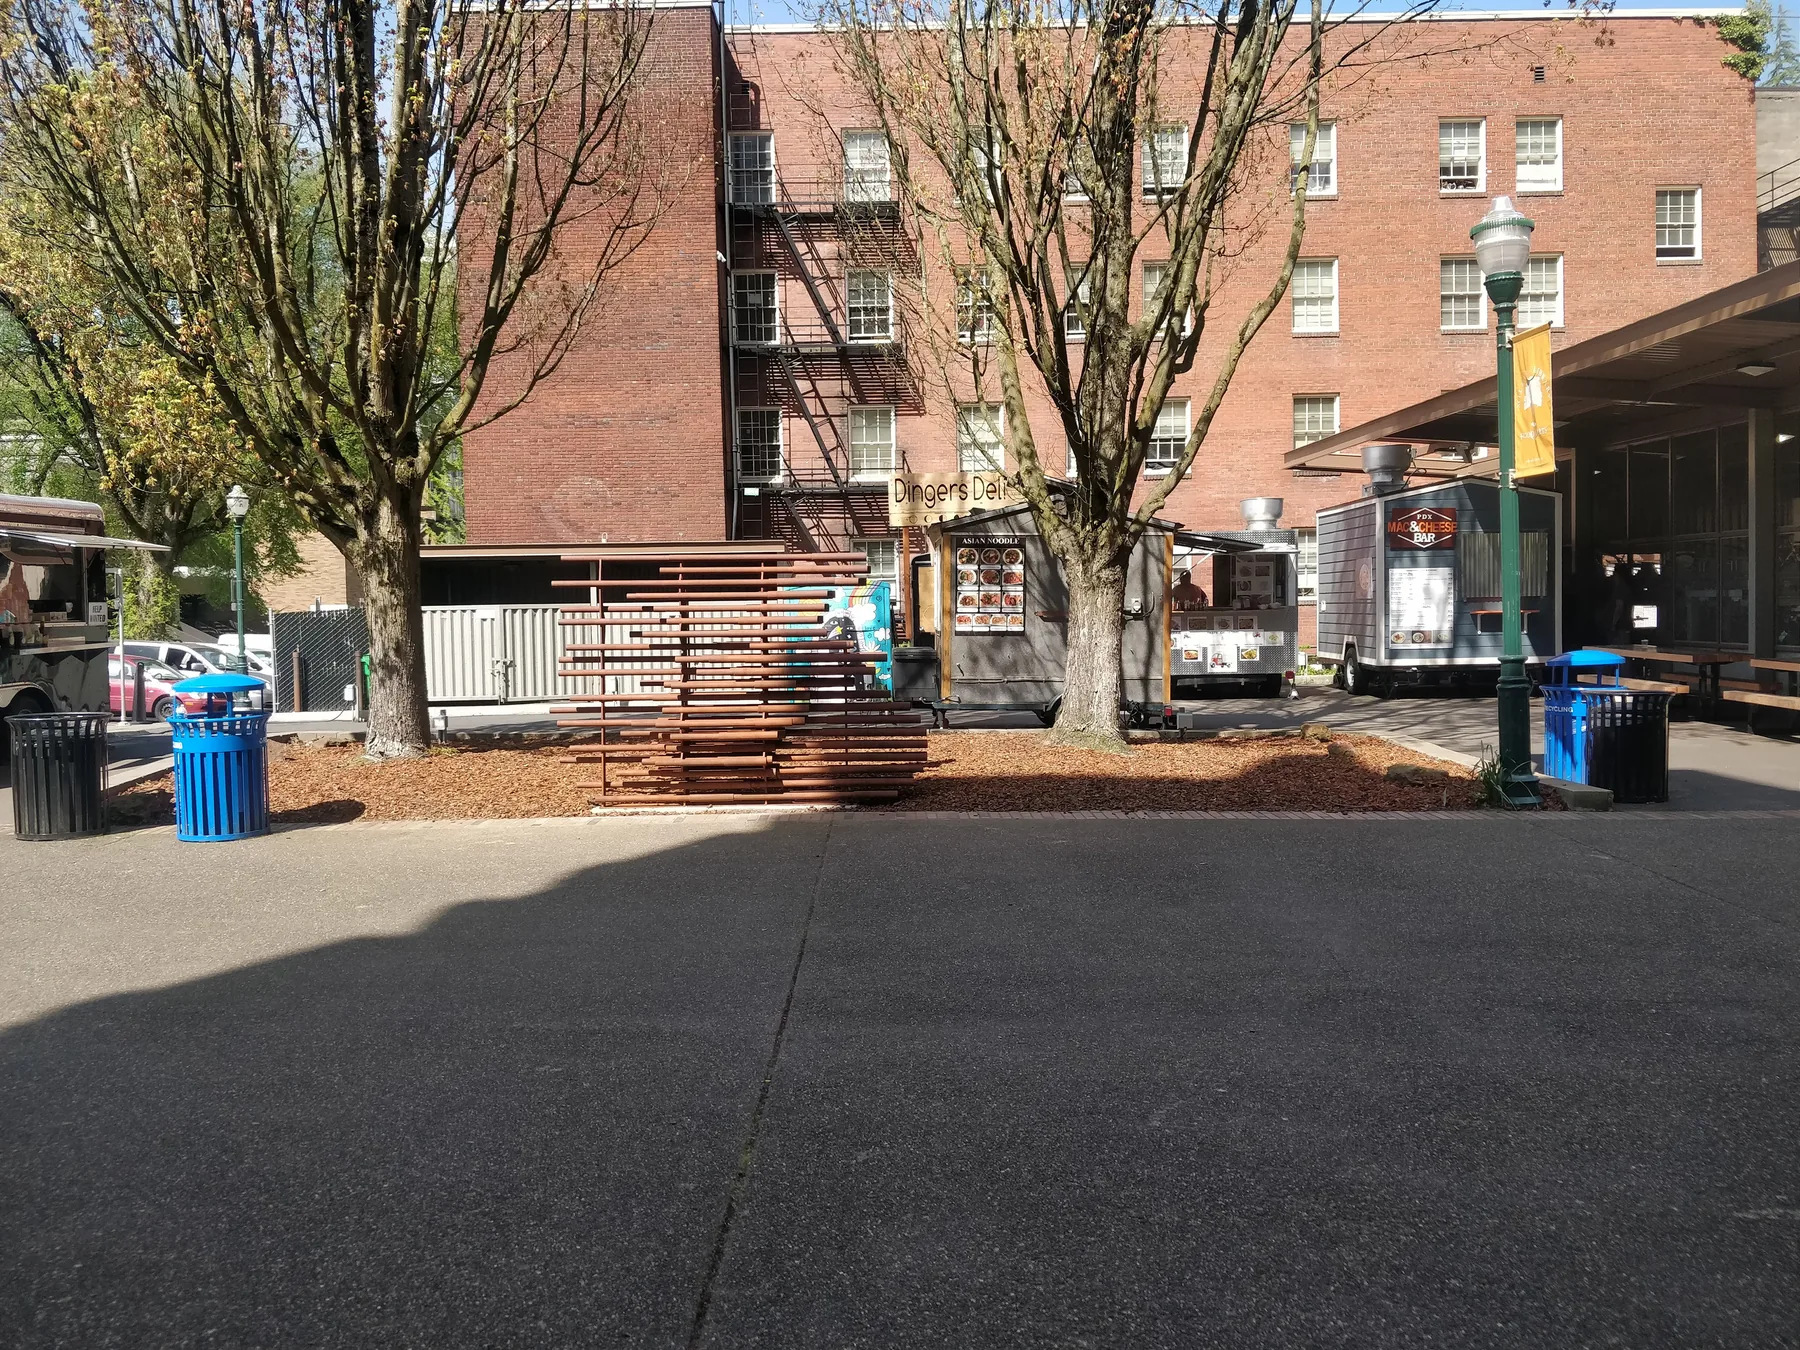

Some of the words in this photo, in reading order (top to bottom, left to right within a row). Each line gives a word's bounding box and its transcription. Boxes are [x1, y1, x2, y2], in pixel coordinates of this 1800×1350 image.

[894, 478, 968, 508] Dingers
[973, 476, 1006, 500] Deli
[962, 537, 985, 545] ASIAN
[987, 537, 1020, 545] NOODLE
[1413, 532, 1436, 543] BAR
